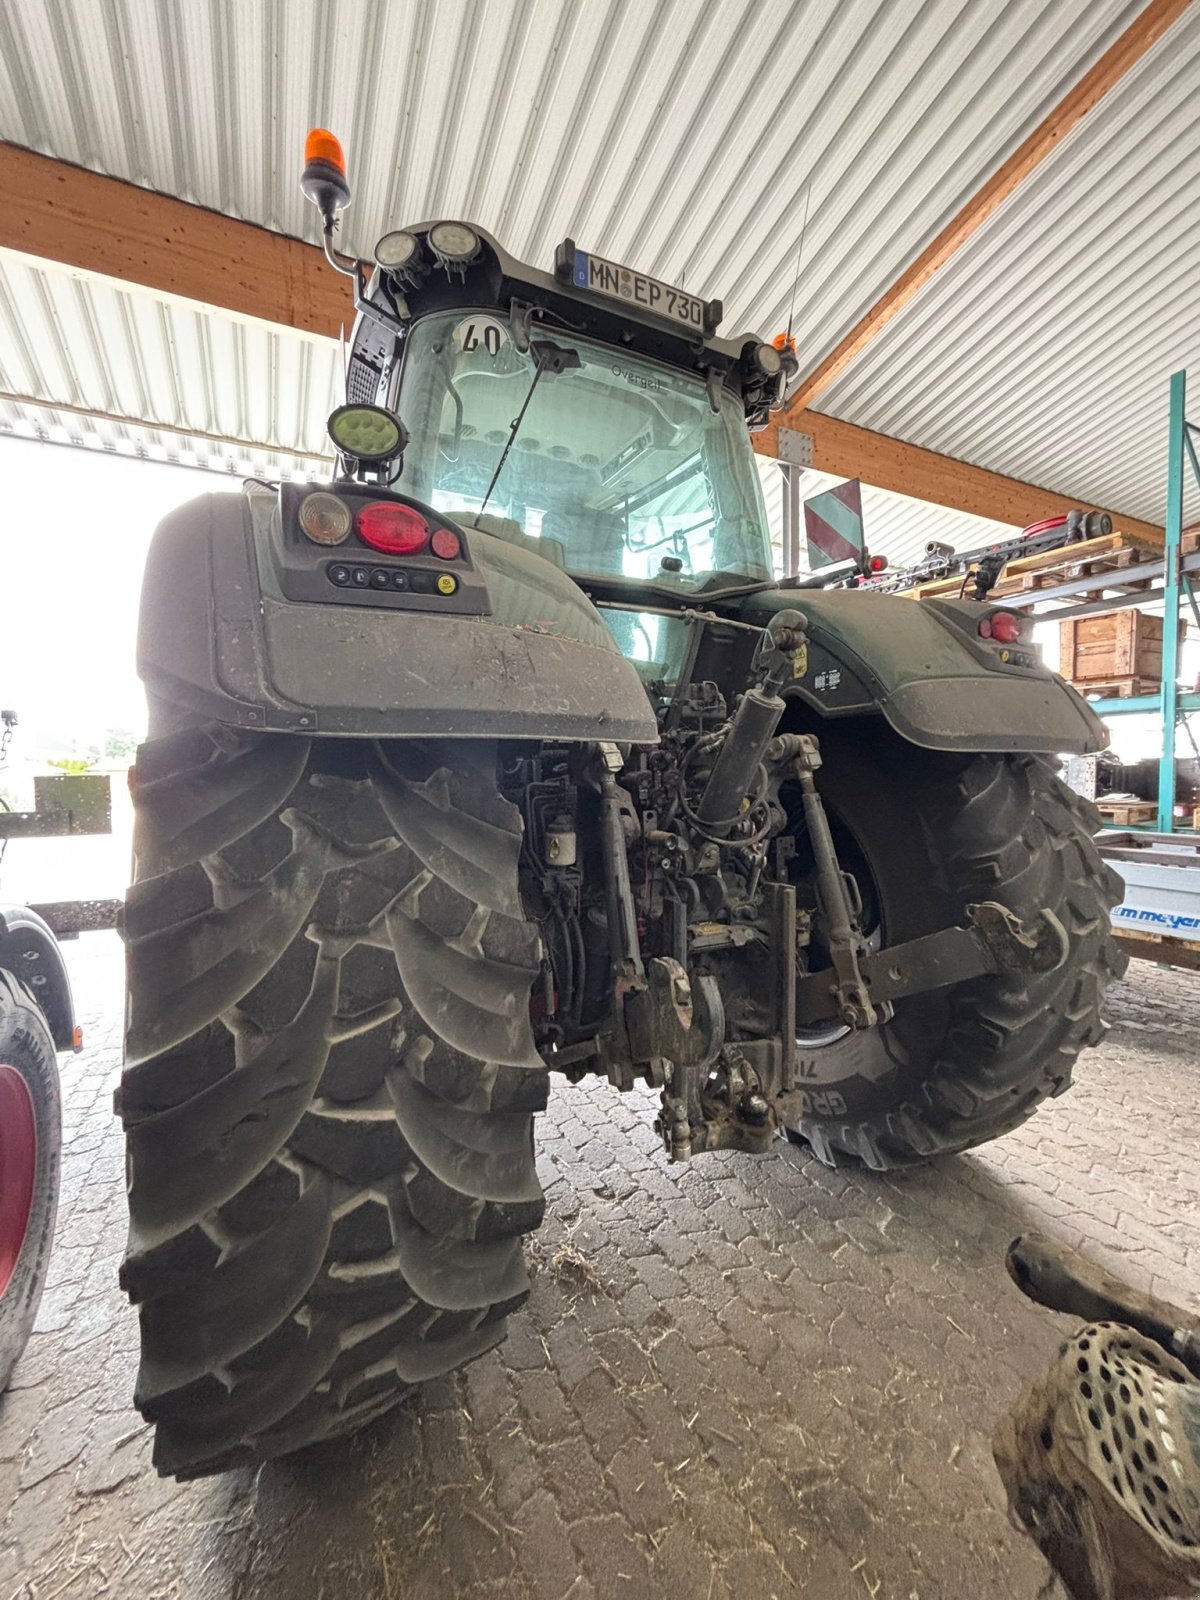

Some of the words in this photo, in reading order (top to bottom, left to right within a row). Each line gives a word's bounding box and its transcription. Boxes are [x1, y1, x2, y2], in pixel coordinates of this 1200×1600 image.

[590, 259, 619, 294] MN
[634, 276, 661, 307] EP
[666, 290, 701, 325] 730
[462, 324, 501, 357] 40
